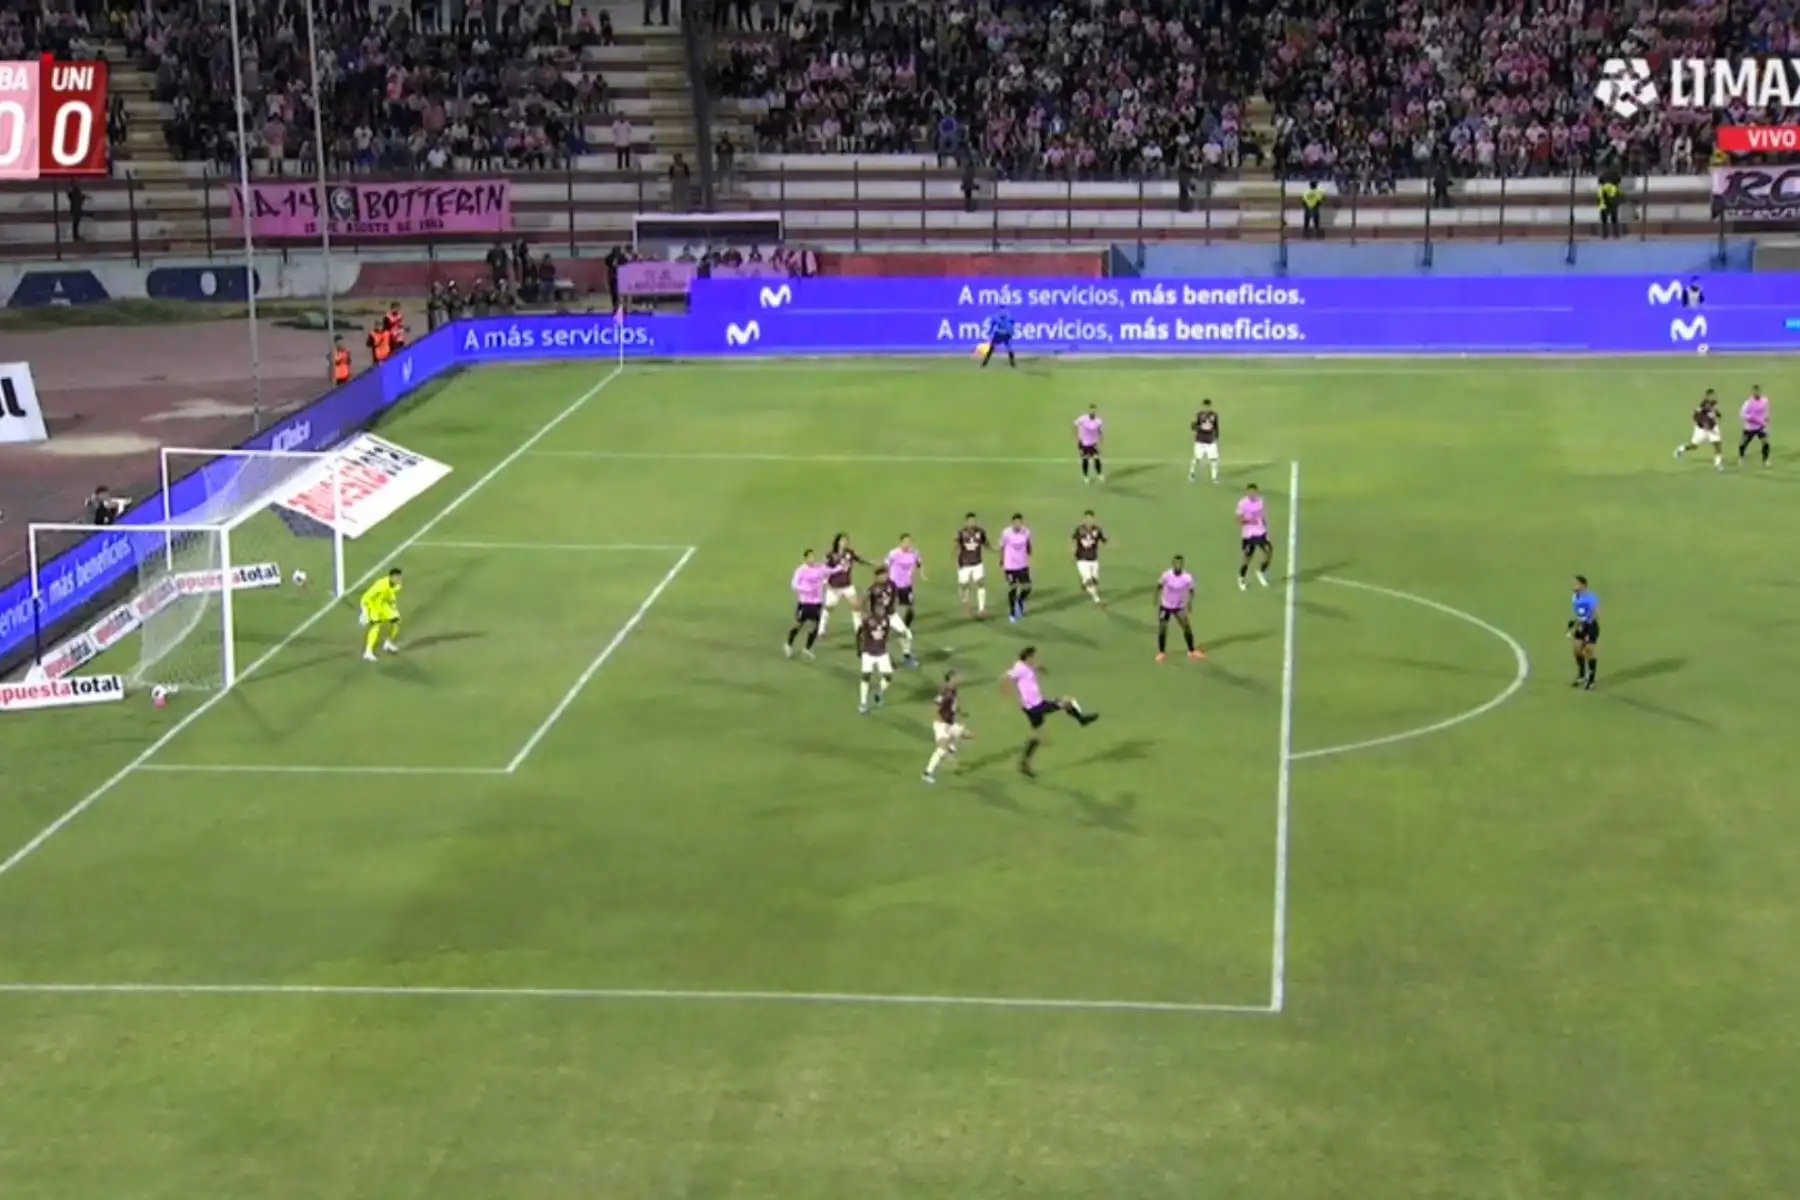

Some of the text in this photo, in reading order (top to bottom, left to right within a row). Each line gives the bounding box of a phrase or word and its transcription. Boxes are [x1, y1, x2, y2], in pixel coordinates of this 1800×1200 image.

[957, 283, 1305, 307] A más servicios, más beneficios.
[464, 328, 480, 350] A
[485, 325, 534, 348] más
[937, 320, 954, 340] A
[1012, 319, 1113, 342] servicios,
[1120, 318, 1169, 340] más
[1176, 318, 1305, 341] beneficios.
